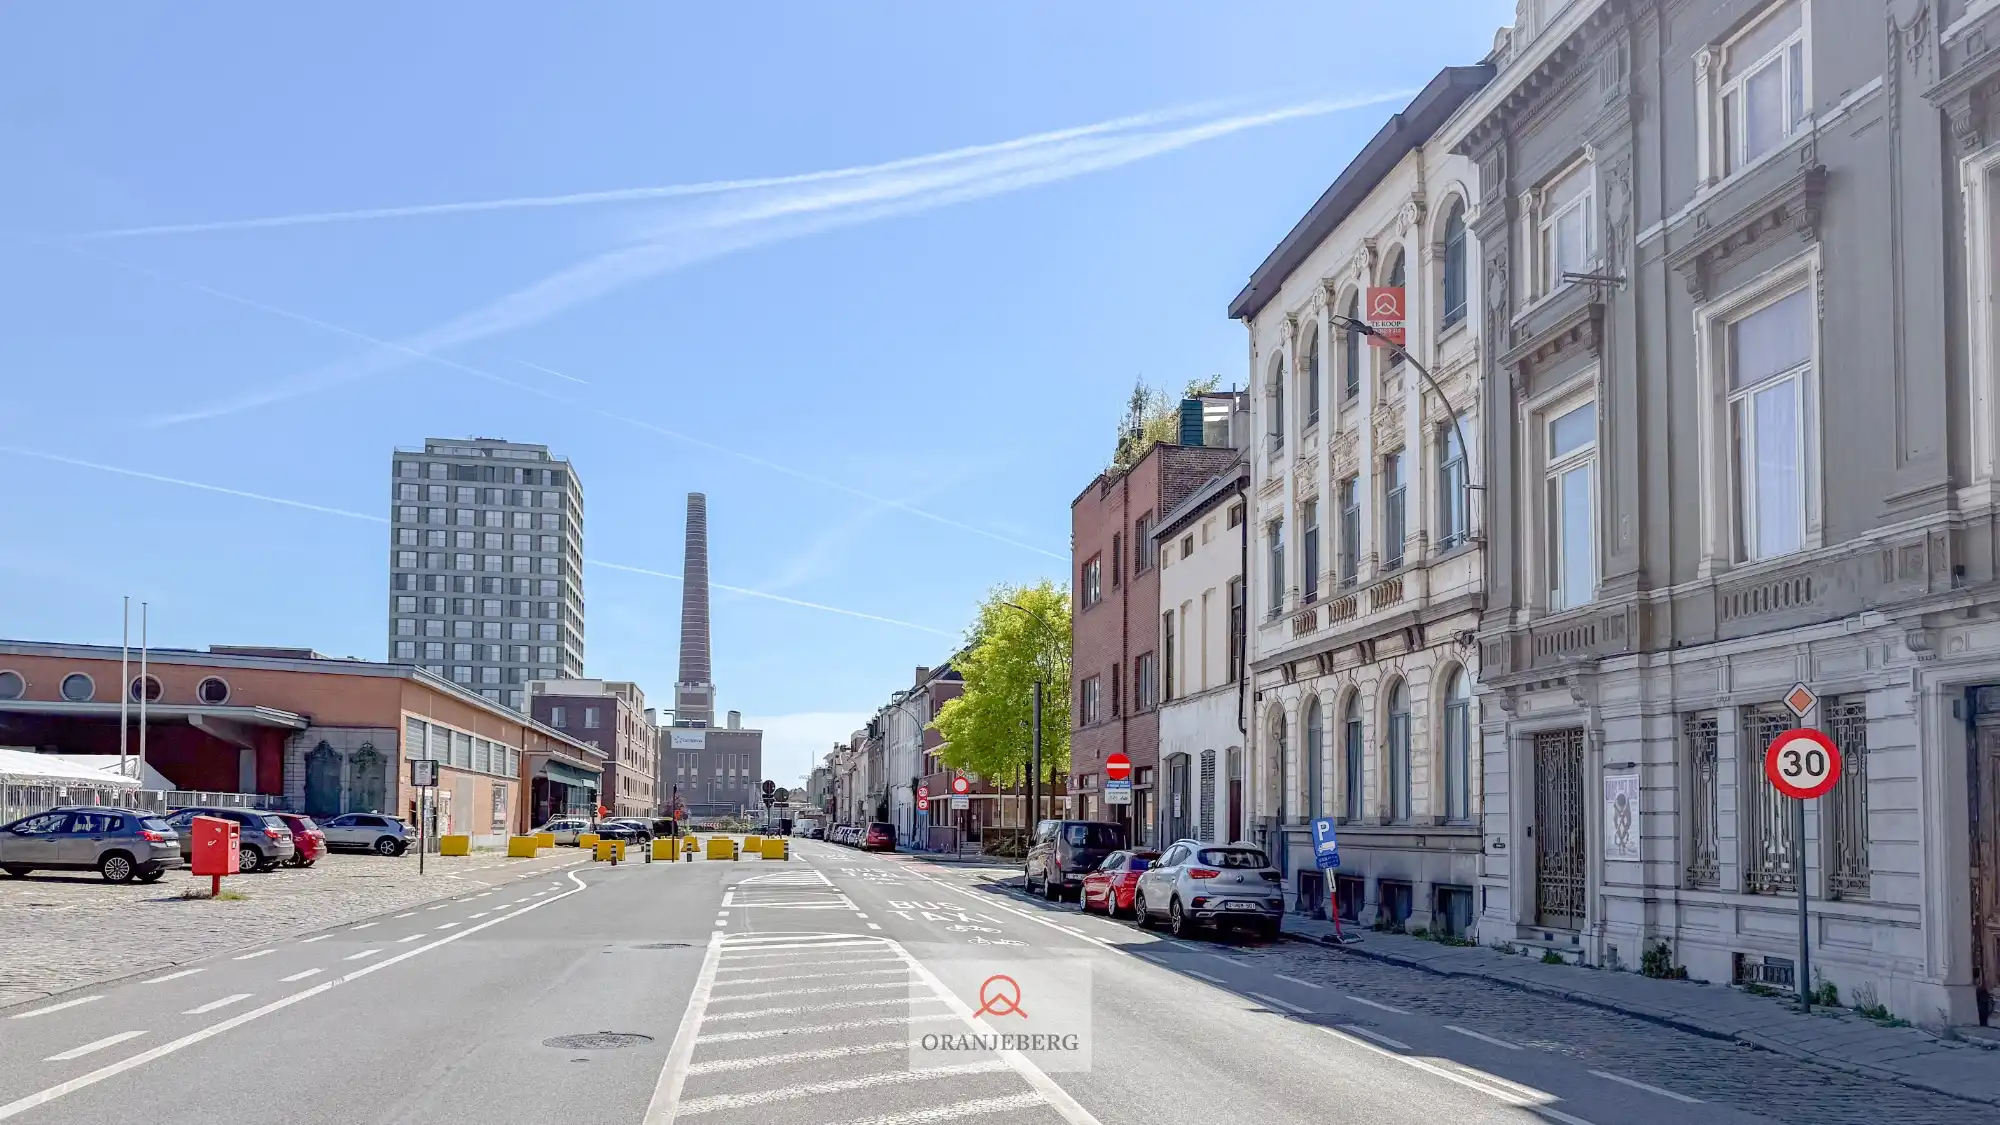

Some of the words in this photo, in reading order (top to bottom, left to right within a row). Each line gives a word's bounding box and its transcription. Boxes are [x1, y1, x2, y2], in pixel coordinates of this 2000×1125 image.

[1783, 750, 1825, 777] 30
[1317, 820, 1330, 841] P
[887, 900, 967, 911] BUS
[885, 910, 1005, 924] TAXI
